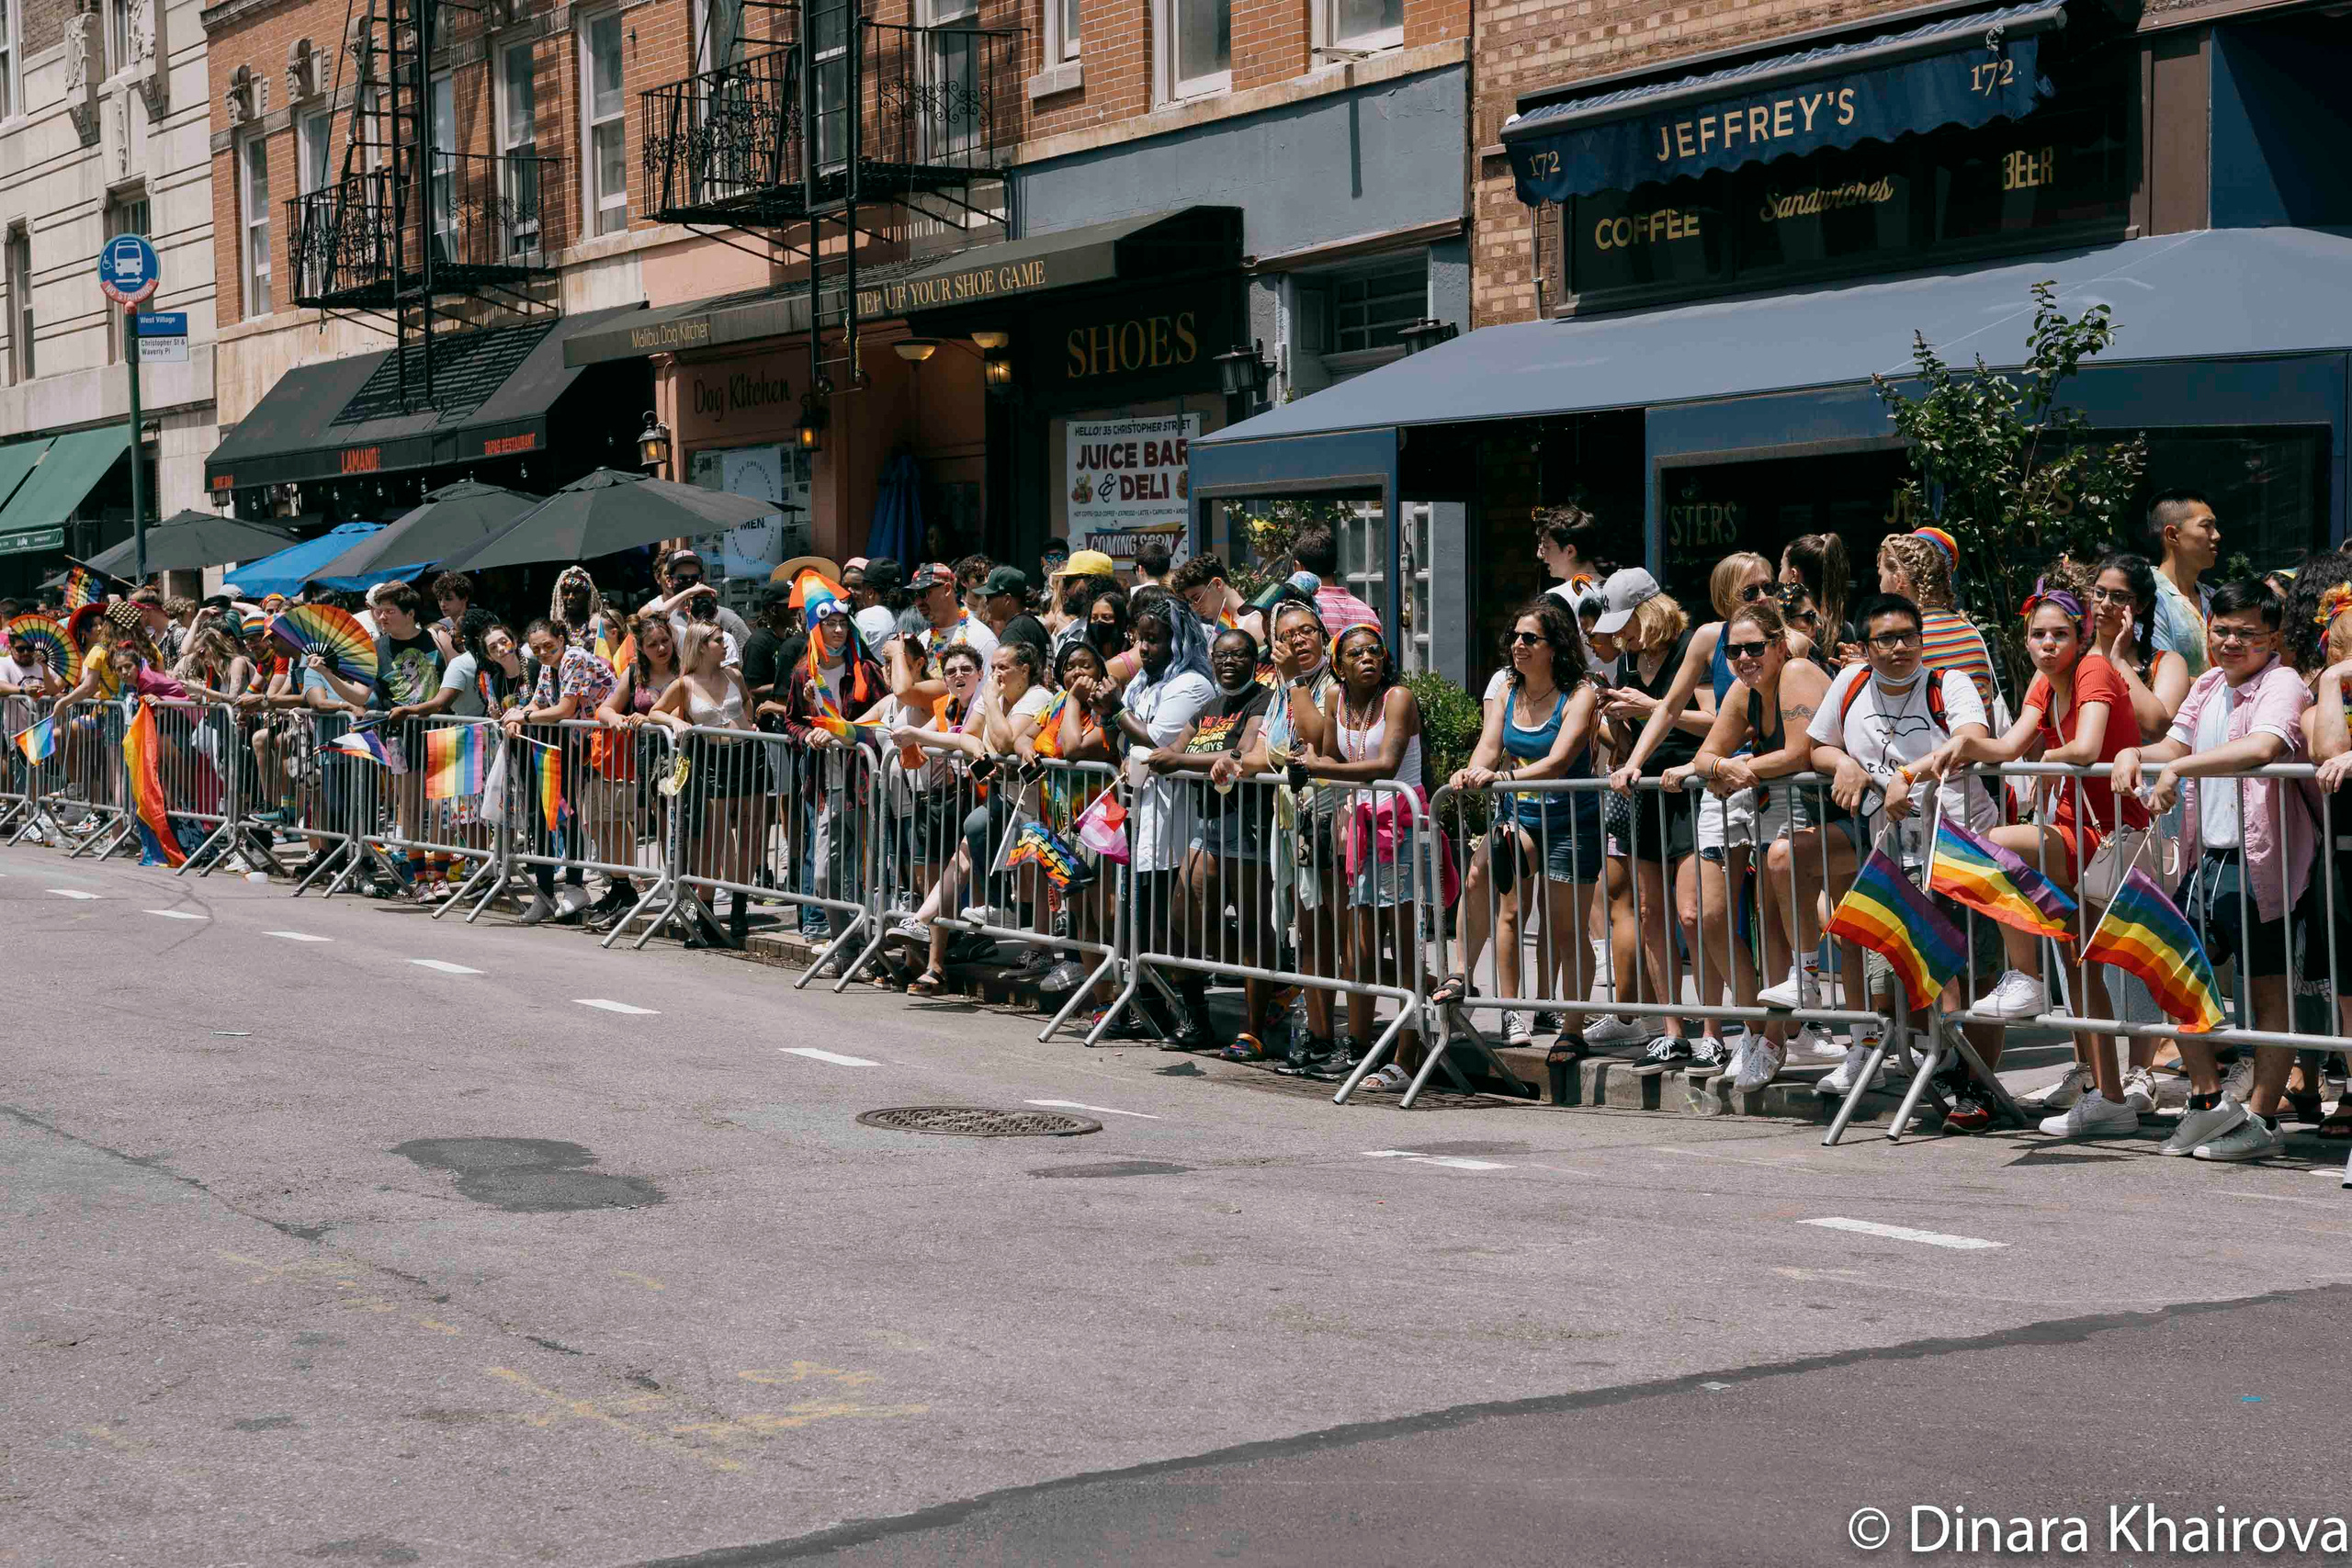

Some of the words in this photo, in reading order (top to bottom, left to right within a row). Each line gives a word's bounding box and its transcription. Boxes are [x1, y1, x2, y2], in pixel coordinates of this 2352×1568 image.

[1970, 59, 2014, 96] 172
[1657, 89, 1855, 163] JEFFREY'S
[1528, 151, 1561, 182] 172
[2002, 145, 2054, 191] BEER
[1759, 175, 1894, 223] Sandwiches
[1595, 208, 1700, 251] COFFEE
[105, 283, 116, 297] NO
[118, 283, 154, 301] STANDING
[855, 290, 882, 315] TEP
[886, 286, 905, 310] UP
[909, 277, 952, 306] YOUR
[955, 269, 995, 299] SHOE
[999, 260, 1046, 291] GAME
[155, 316, 176, 324] Village
[631, 330, 659, 349] Malibu
[661, 324, 678, 346] Dog
[679, 321, 710, 342] Kitchen
[141, 339, 172, 347] Christopher
[1068, 310, 1197, 378] SHOES
[694, 378, 724, 423] Dog
[729, 369, 792, 411] Kitchen
[1075, 426, 1102, 436] HELLO!
[1102, 425, 1112, 435] 35
[1114, 422, 1161, 434] CHRISTOPHER
[1162, 420, 1191, 431] STRET
[1076, 443, 1137, 470] JUICE
[1144, 438, 1188, 468] BAR
[1098, 473, 1116, 503] &
[1120, 473, 1170, 502] DELI
[1091, 534, 1136, 556] COMING
